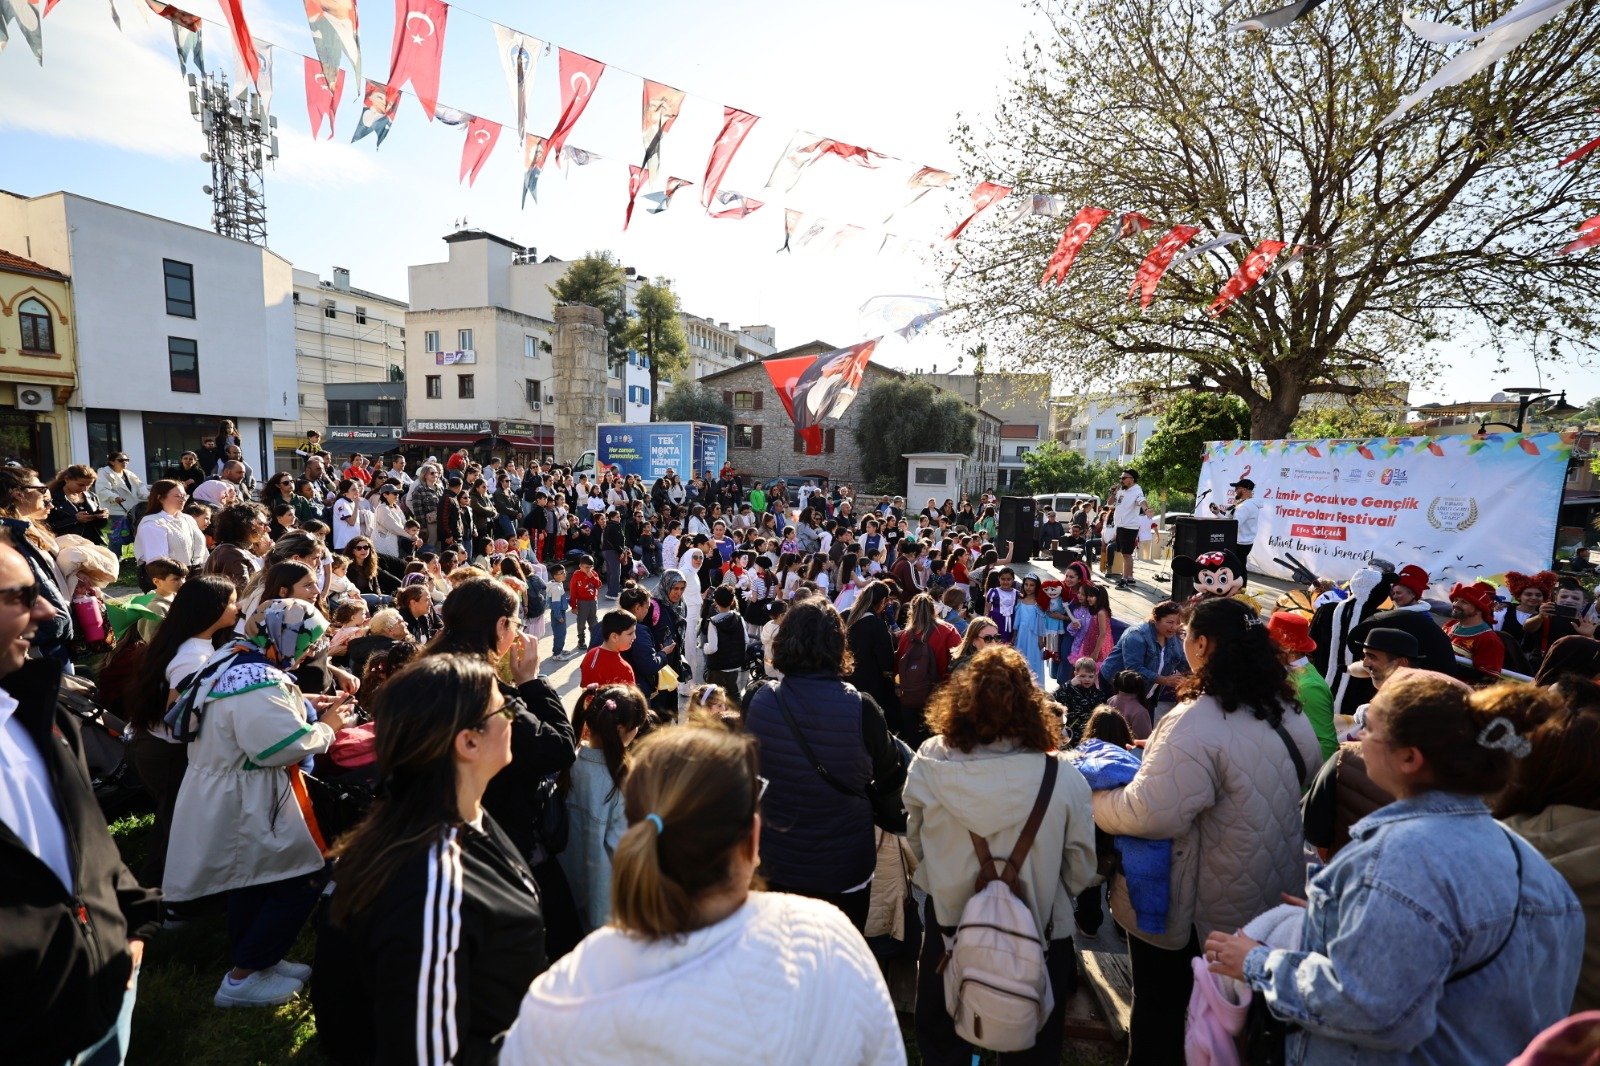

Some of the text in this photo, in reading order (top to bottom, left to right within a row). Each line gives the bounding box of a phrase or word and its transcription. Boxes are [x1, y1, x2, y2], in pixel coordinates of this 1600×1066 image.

[418, 422, 478, 430] EFES RESTAURANT
[657, 436, 674, 445] TEK
[651, 446, 680, 455] NOKTA
[1263, 487, 1419, 511] 2. İzmir Çocuk ve Gençlik
[1276, 505, 1398, 528] Tiyatroları Festivali
[1311, 526, 1342, 539] Selçuk
